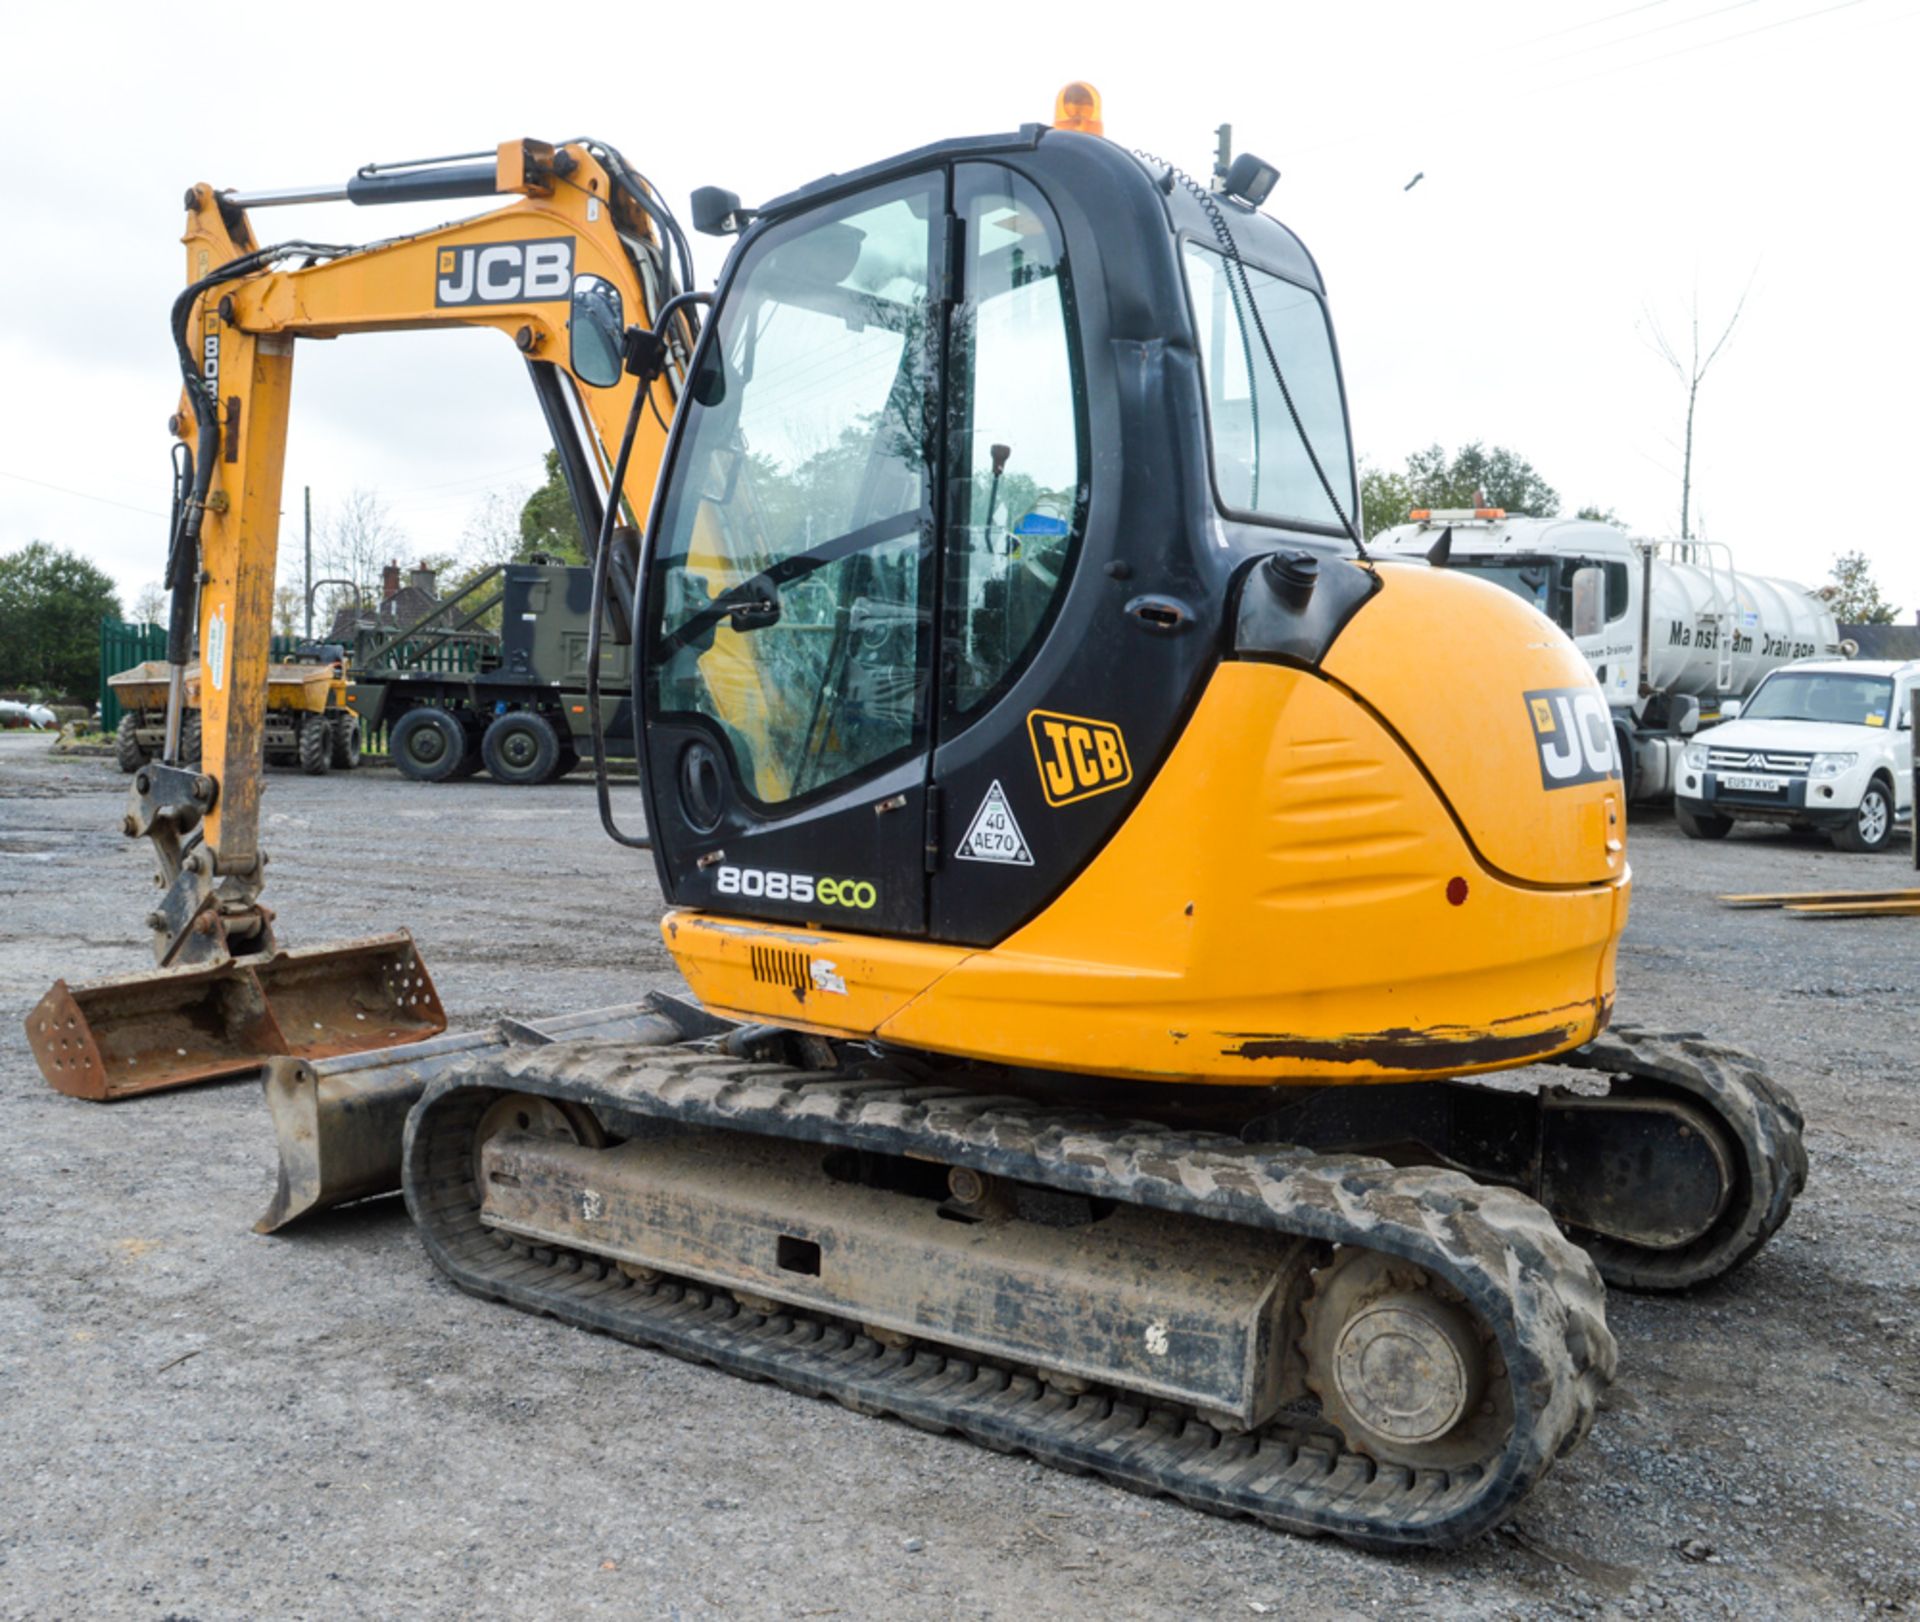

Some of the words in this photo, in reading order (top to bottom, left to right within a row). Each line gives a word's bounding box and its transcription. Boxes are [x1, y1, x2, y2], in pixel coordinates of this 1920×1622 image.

[439, 242, 571, 303] JCB
[1043, 720, 1123, 796] JCB
[1541, 695, 1621, 779] JC
[975, 832, 1014, 851] AE70
[986, 813, 1005, 830] 40
